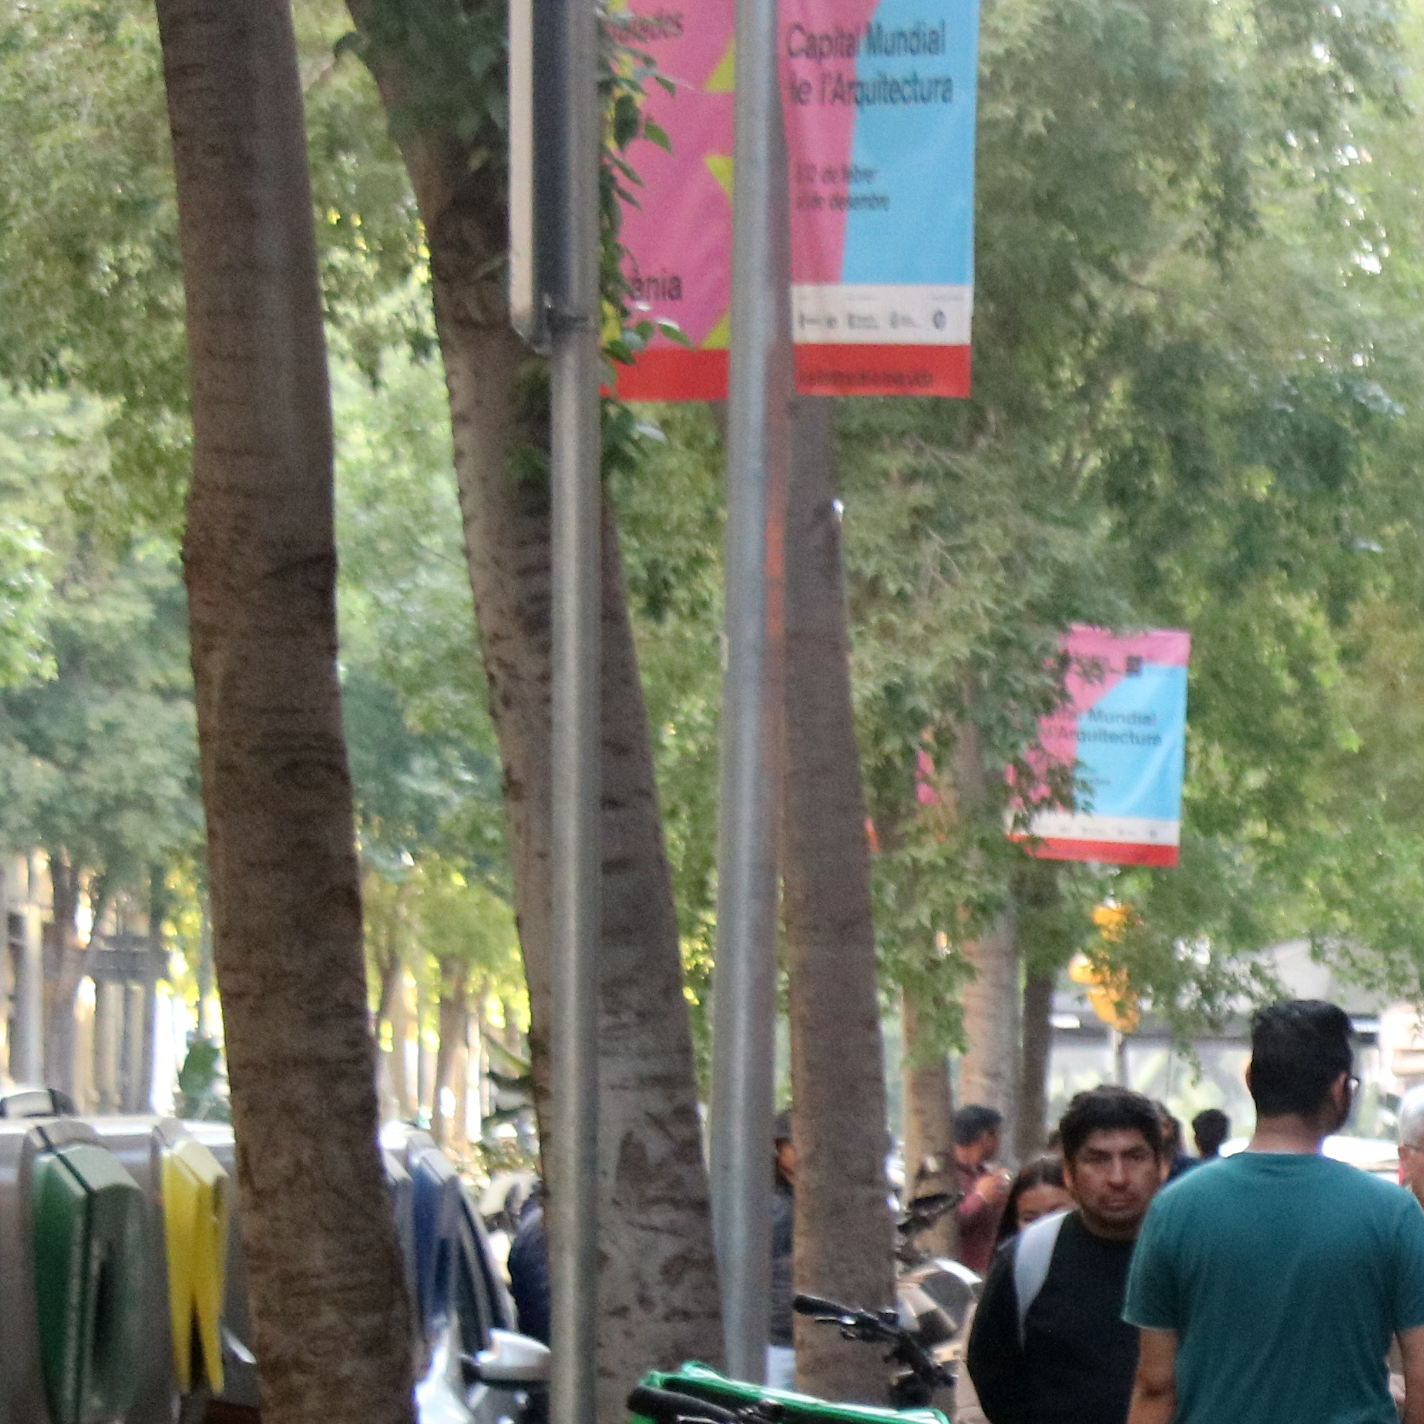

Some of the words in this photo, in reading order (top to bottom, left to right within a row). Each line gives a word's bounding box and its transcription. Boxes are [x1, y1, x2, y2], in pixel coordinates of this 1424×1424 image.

[785, 22, 860, 62] Capital
[866, 19, 946, 58] Mundial
[820, 70, 955, 114] l'Arquitectura
